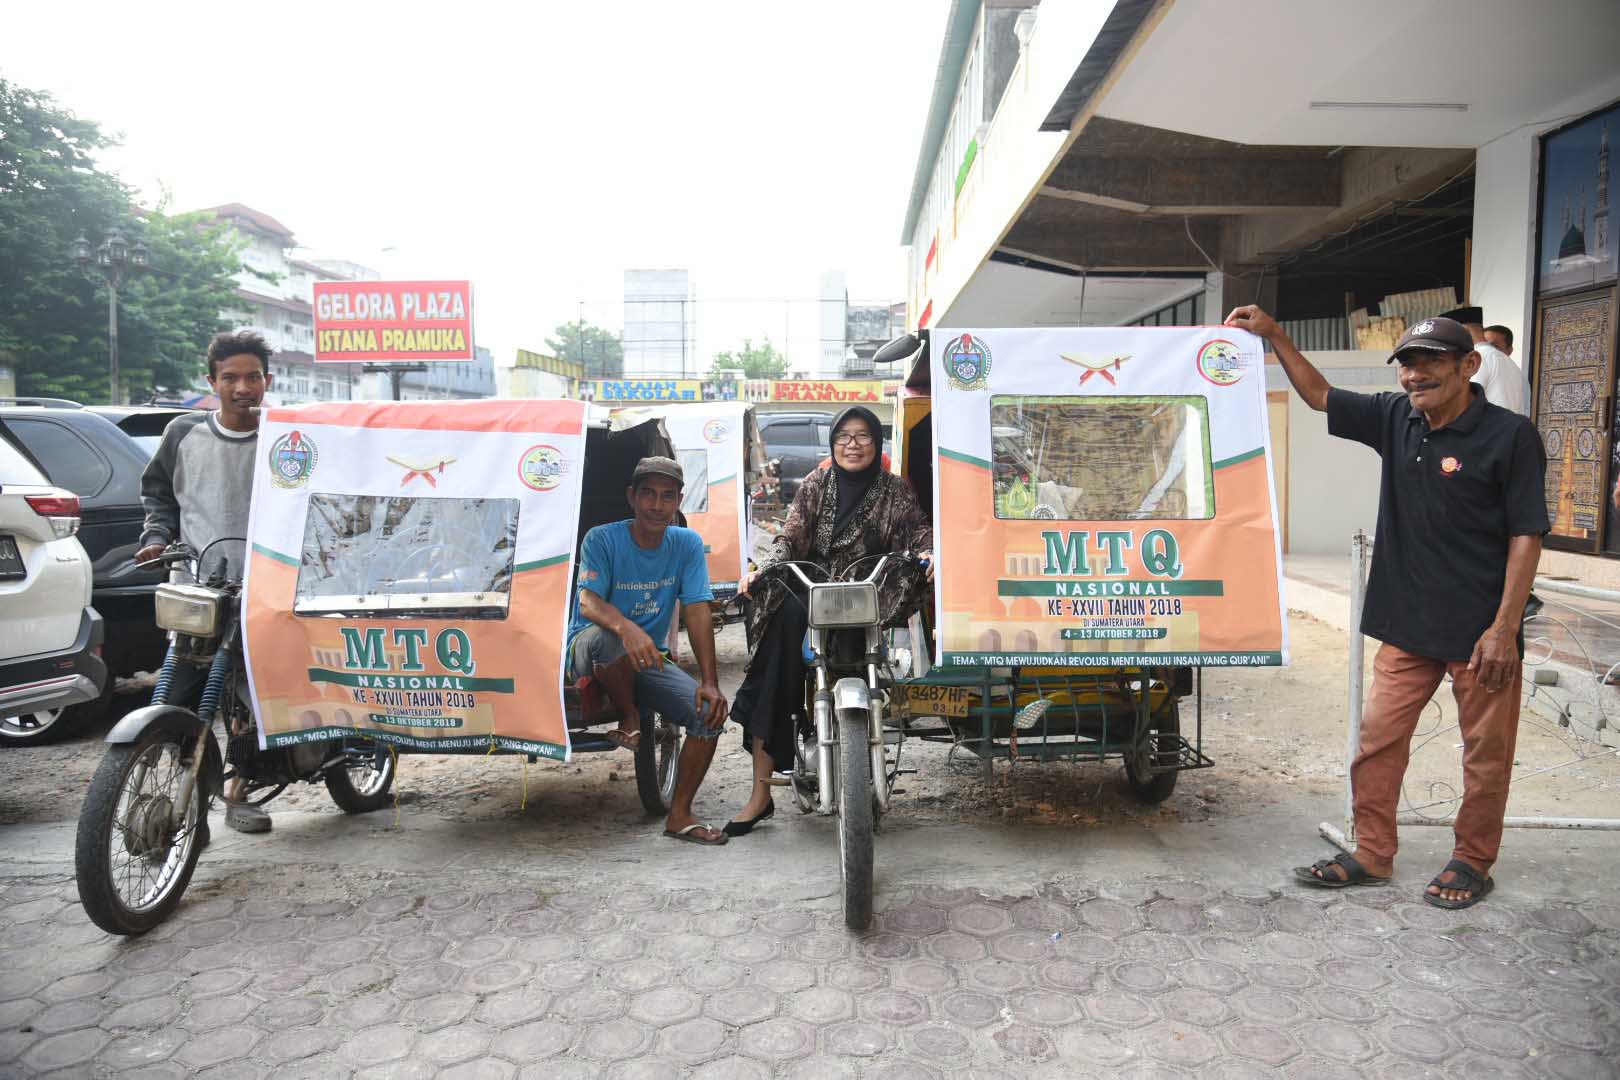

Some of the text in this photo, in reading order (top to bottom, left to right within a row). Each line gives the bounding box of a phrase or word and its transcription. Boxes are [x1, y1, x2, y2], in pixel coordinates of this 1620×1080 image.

[317, 291, 465, 320] GELORA PLAZA
[319, 328, 466, 353] ISTANA PRAMUKA
[602, 388, 695, 400] SEKOLAH
[775, 383, 836, 392] ISTANA
[774, 391, 879, 401] PRAMUKA
[1041, 528, 1184, 580] MTQ
[1056, 582, 1170, 596] NASIONAL
[1048, 599, 1061, 616] KE
[1108, 599, 1145, 616] TAHUN
[1150, 599, 1182, 616] 2018
[1083, 618, 1145, 627] DI SUMATERA UTARA
[1064, 629, 1071, 638] 4
[1080, 629, 1092, 638] 13
[1094, 629, 1133, 639] OKTOBER
[1135, 629, 1159, 638] 2018
[340, 626, 477, 676] MTQ
[952, 656, 978, 665] TEMA:
[1005, 656, 1067, 666] MEWUJUDKAN
[1069, 656, 1109, 666] REVOLUSI
[1111, 656, 1134, 665] MENT
[1137, 656, 1171, 666] MENUJU
[1173, 656, 1200, 665] INSAN
[1202, 655, 1228, 665] YANG
[358, 675, 464, 690] NASIONAL
[353, 688, 366, 703] KE
[406, 692, 443, 707] TAHUN
[447, 692, 475, 708] 2018
[393, 707, 423, 716] SUMATERA
[423, 708, 443, 716] UTARA
[372, 714, 378, 722] 4
[385, 716, 396, 724] 13
[397, 717, 431, 727] OKTOBER
[434, 718, 456, 727] 2018
[275, 736, 302, 747] TEMA:
[382, 734, 415, 746] REVOLUSI
[415, 740, 436, 749] MENT
[438, 738, 471, 748] MENUJU
[500, 740, 521, 749] YANG
